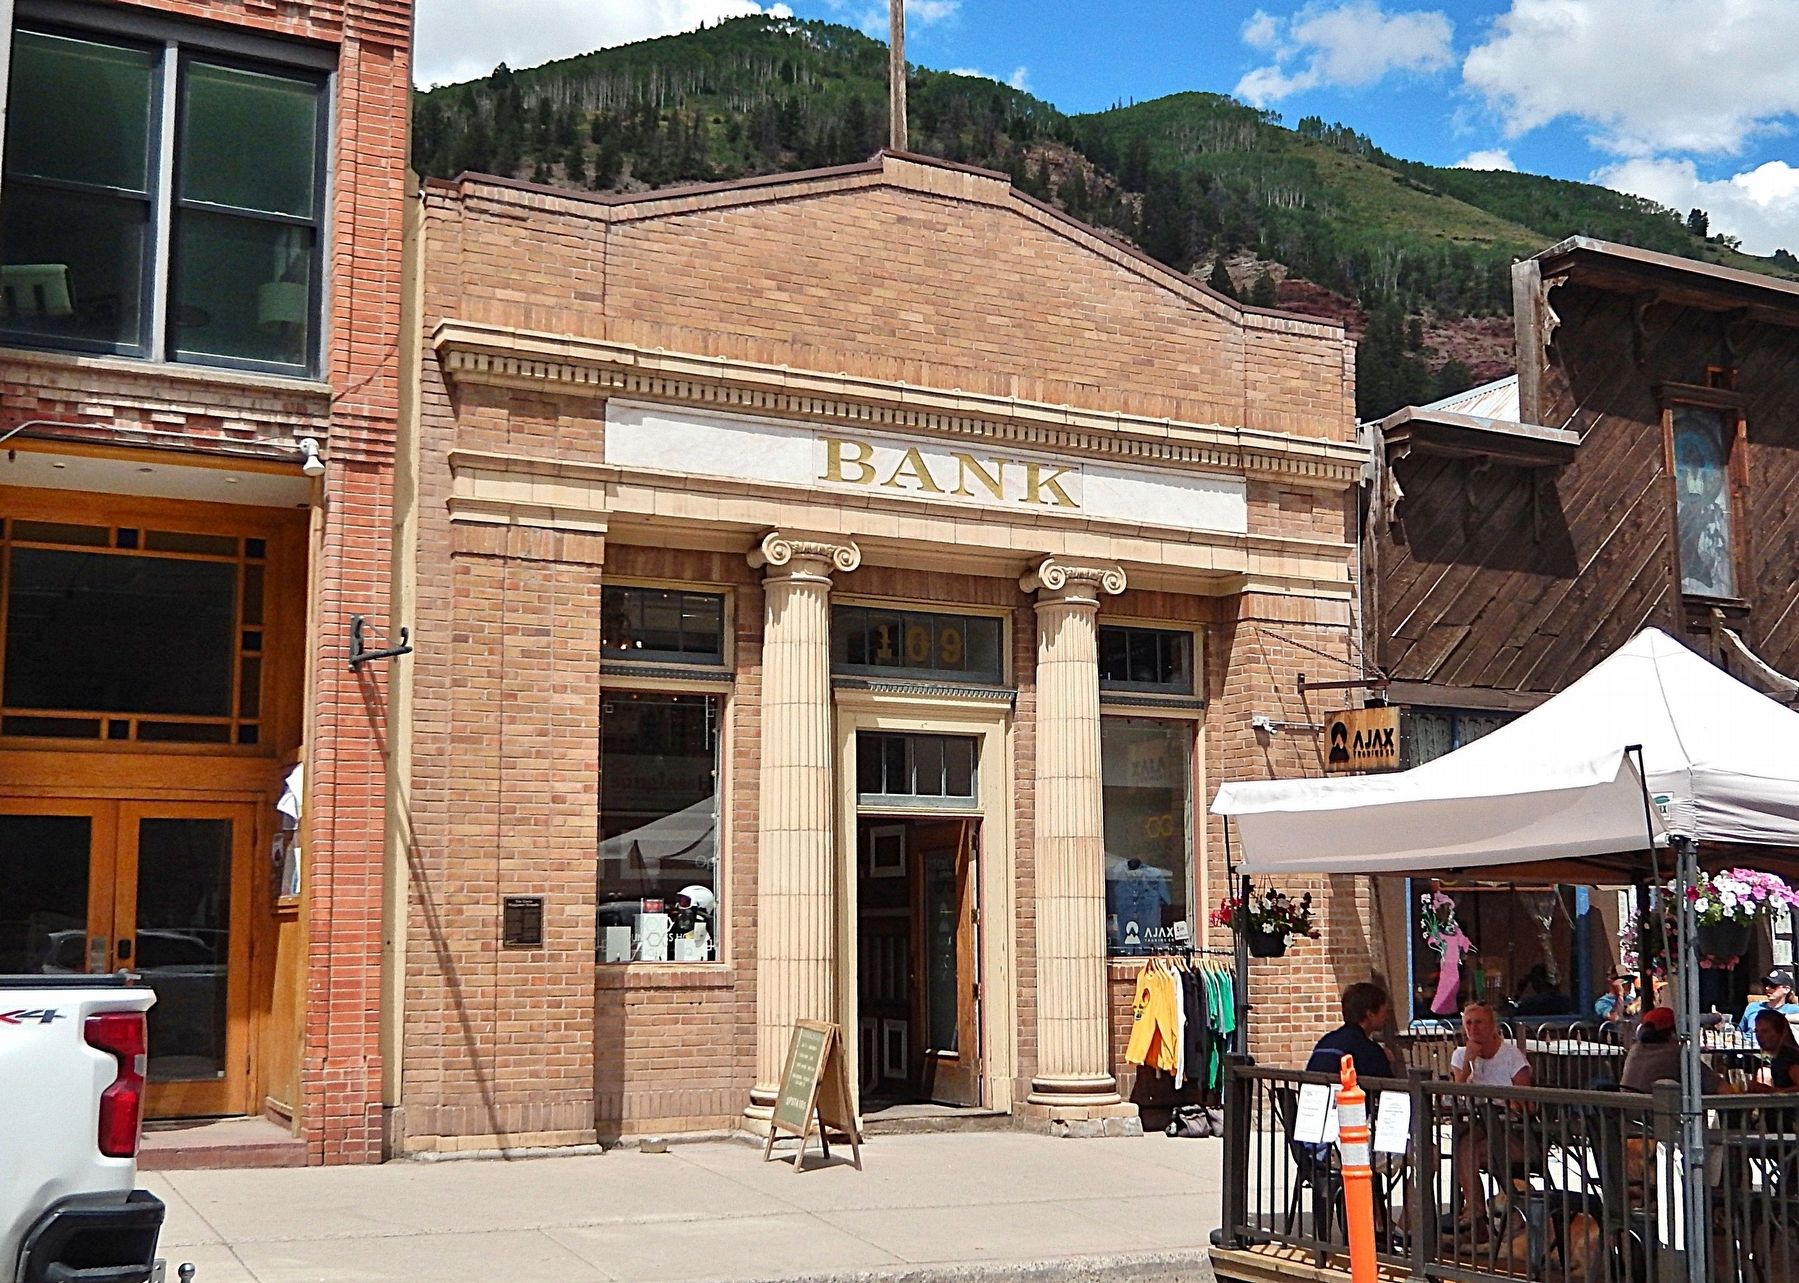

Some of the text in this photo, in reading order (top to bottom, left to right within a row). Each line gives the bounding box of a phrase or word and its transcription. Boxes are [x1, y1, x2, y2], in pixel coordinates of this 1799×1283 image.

[818, 436, 1080, 508] BANK
[1353, 728, 1394, 750] AJAX
[1144, 927, 1174, 937] AJAX
